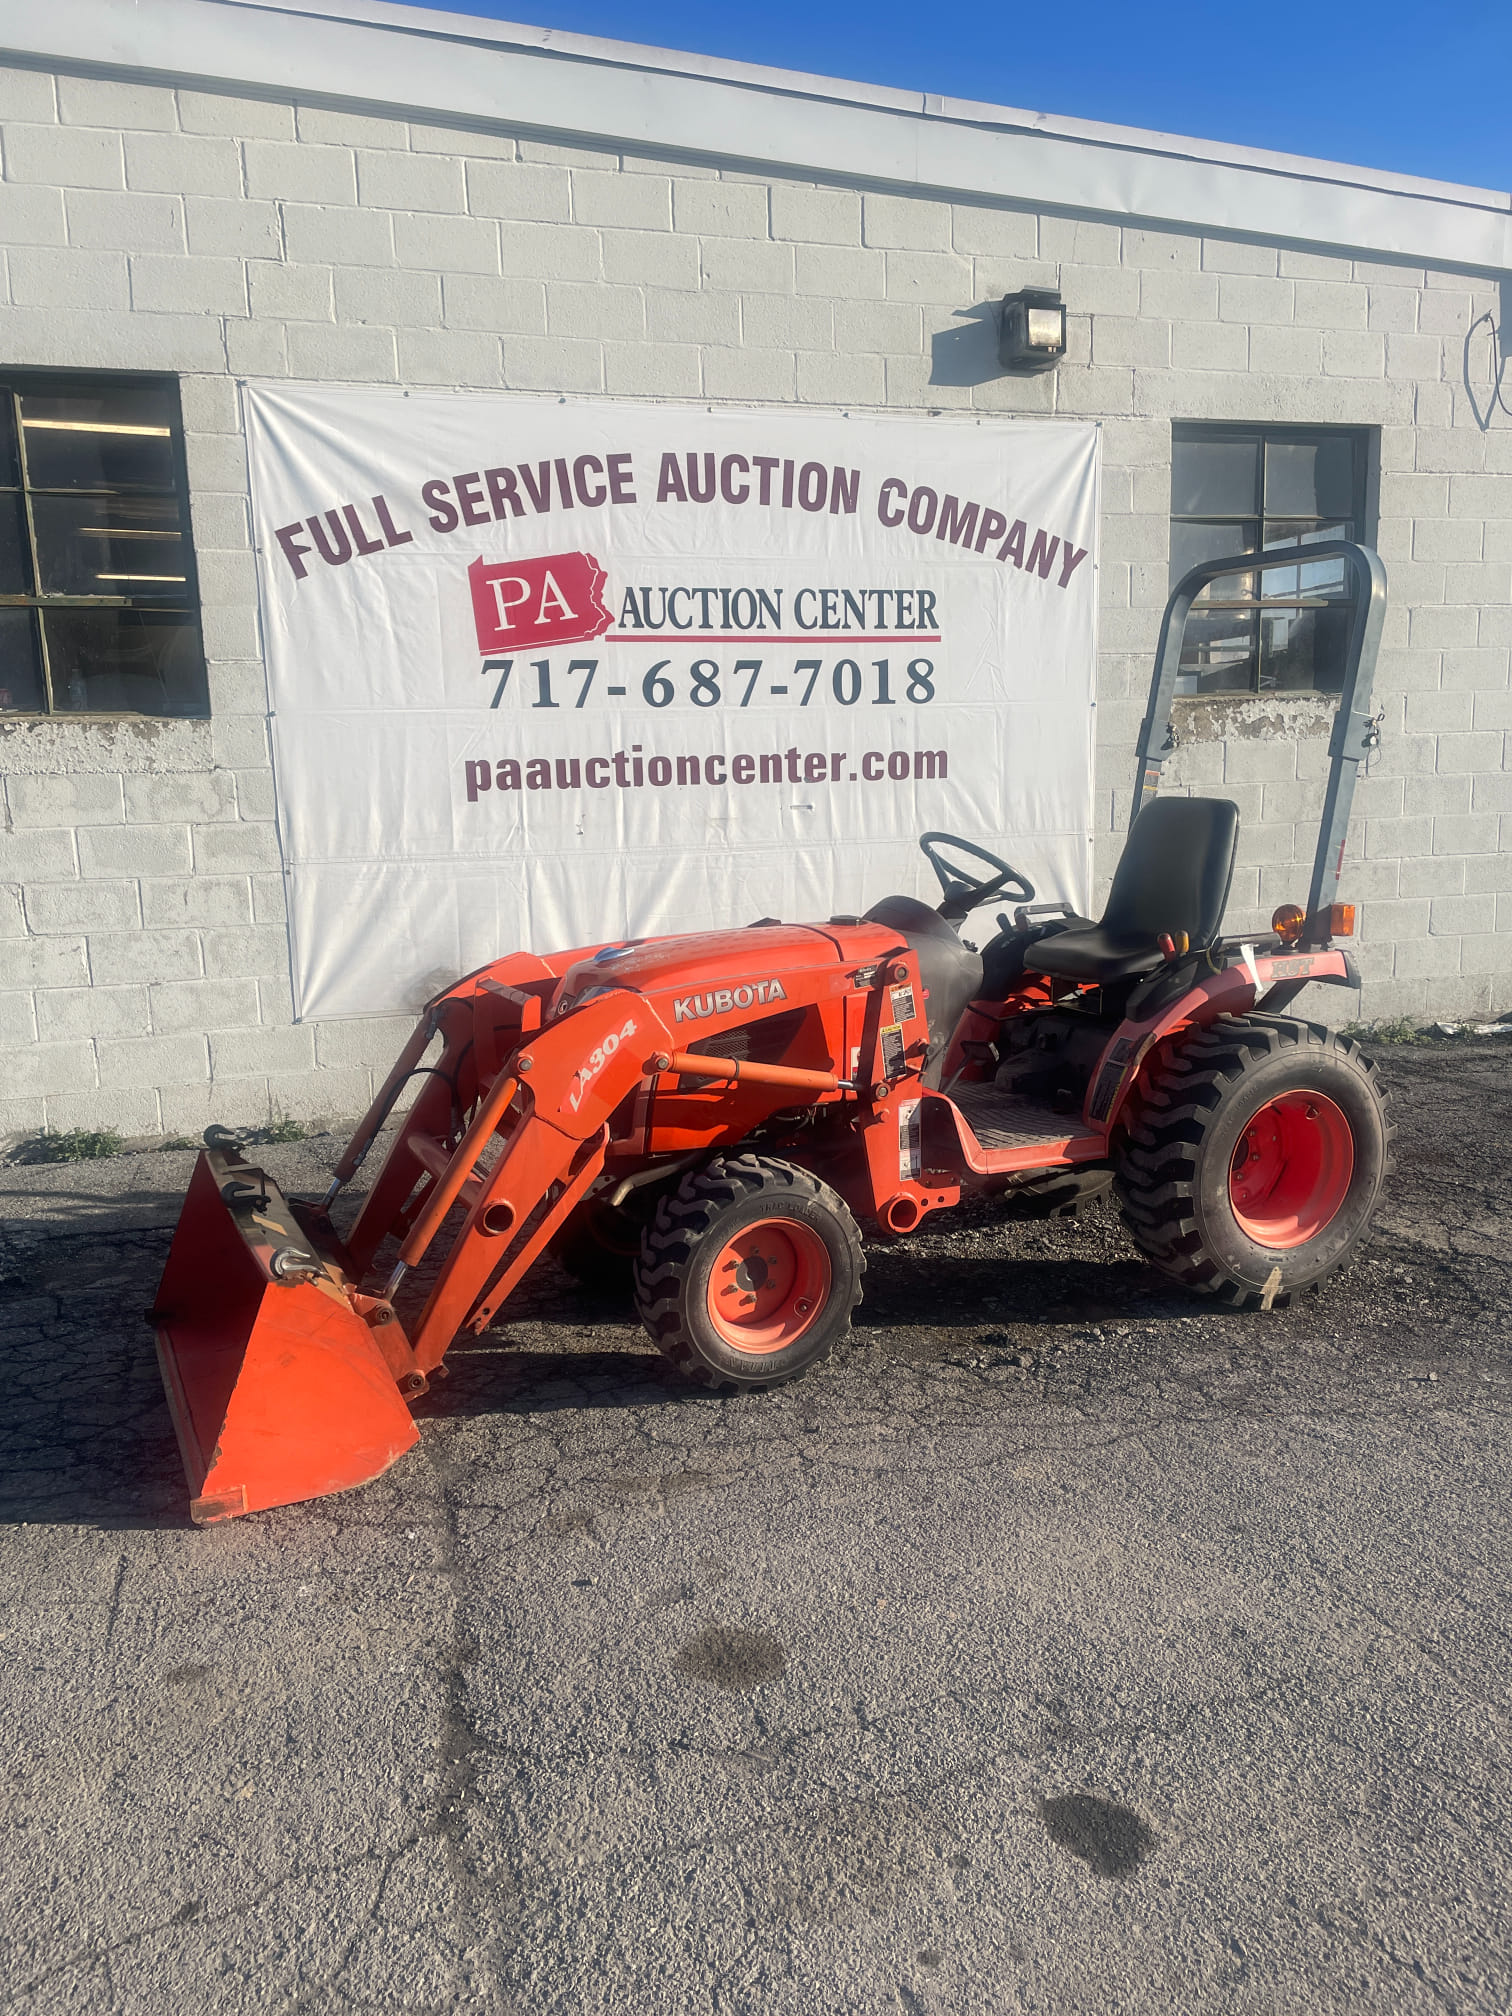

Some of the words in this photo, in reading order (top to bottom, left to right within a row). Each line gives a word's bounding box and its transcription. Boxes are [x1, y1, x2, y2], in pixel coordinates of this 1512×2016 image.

[274, 494, 414, 580] FULL
[421, 452, 637, 534] SERVICE
[656, 452, 861, 515] AUCTION
[877, 477, 1089, 589] COMPANY
[485, 570, 579, 631] PA
[618, 586, 784, 630] AUCTION
[793, 588, 940, 630] CENTER
[481, 658, 935, 709] 717-687-7018
[464, 744, 948, 803] paauctioncenter.com
[673, 978, 787, 1023] KUBOTA
[569, 1019, 638, 1112] LA304
